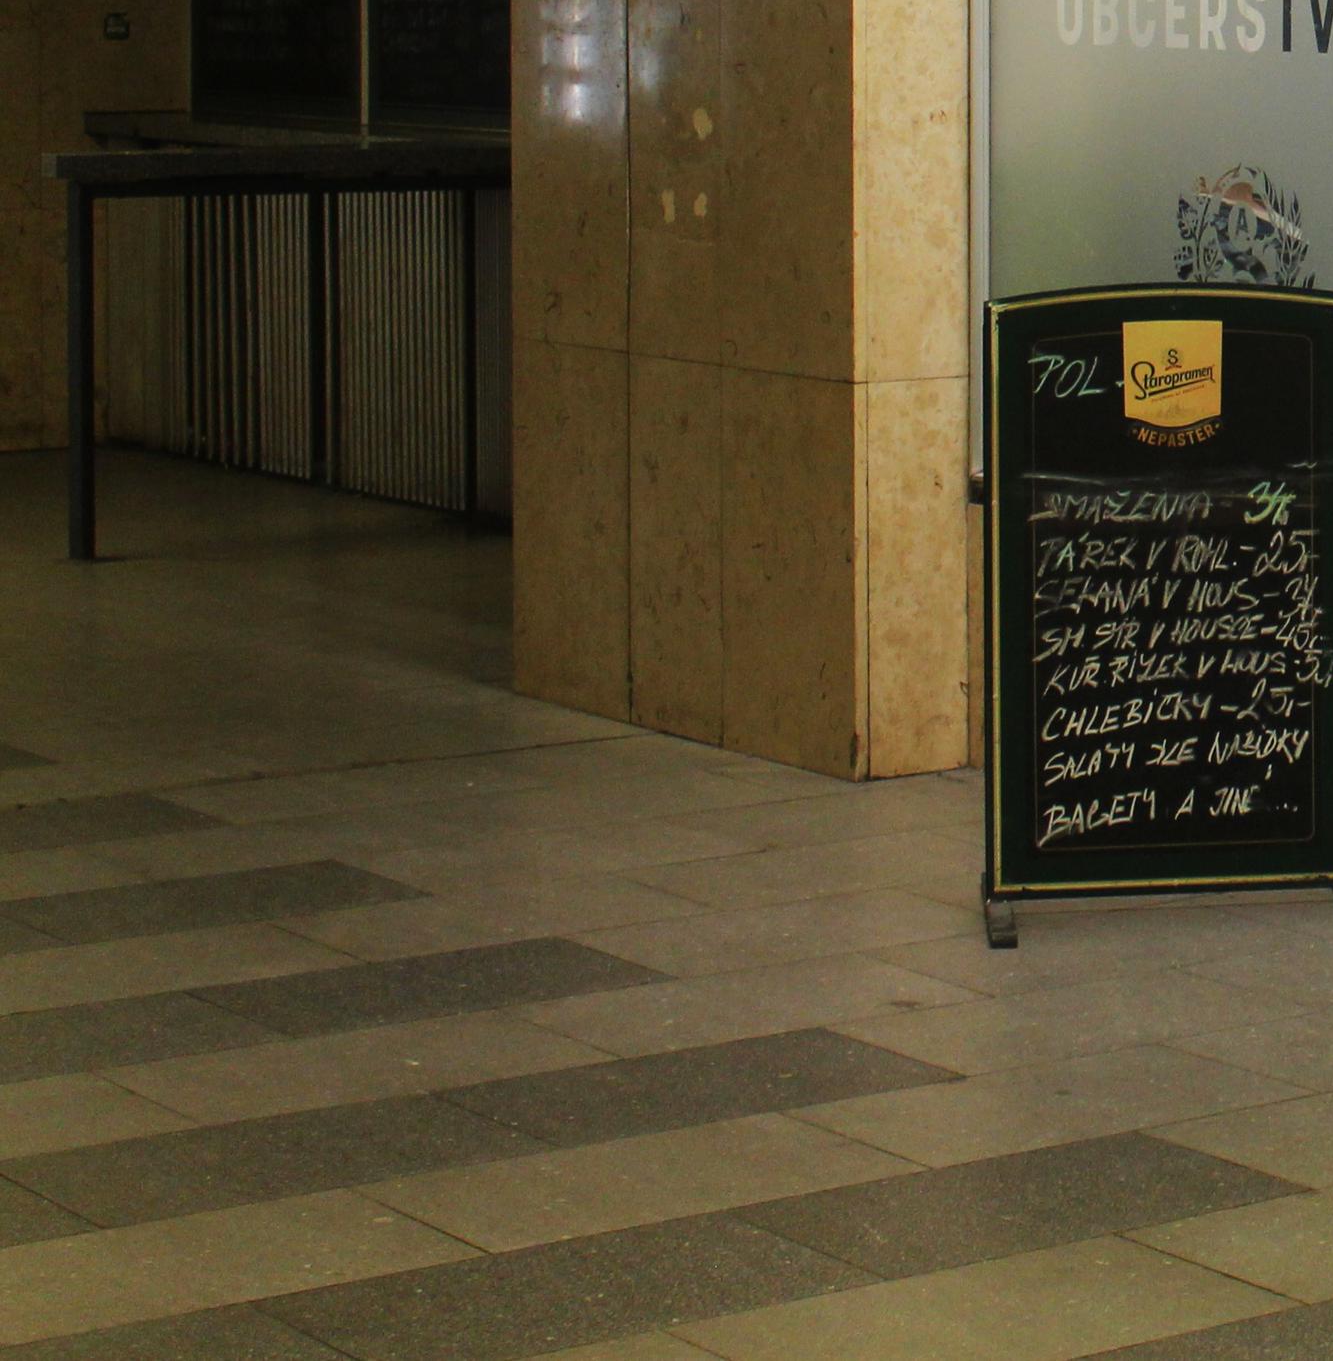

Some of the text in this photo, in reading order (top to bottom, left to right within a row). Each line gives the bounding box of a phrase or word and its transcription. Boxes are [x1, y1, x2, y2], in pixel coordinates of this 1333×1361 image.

[1130, 361, 1216, 401] Staropramen
[1137, 423, 1216, 447] NEPASTER
[1037, 532, 1140, 577] PÁREK
[1146, 538, 1168, 572] V
[1161, 578, 1182, 611] V
[1149, 618, 1166, 649] V
[1198, 652, 1216, 680] V
[1175, 788, 1195, 821] A
